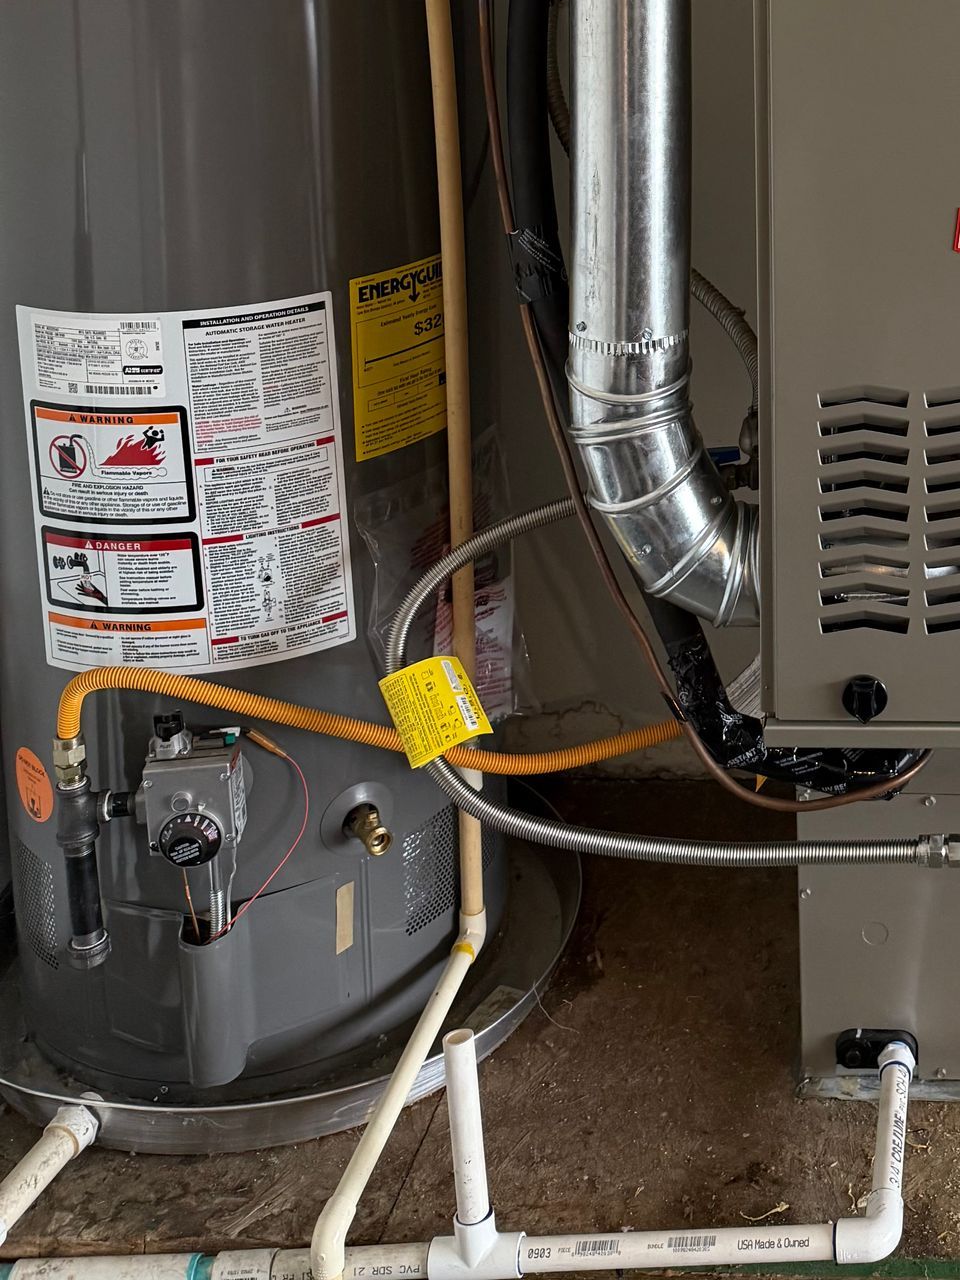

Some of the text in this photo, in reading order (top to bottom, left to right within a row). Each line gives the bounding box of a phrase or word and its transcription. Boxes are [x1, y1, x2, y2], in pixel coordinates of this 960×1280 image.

[358, 260, 442, 304] ENERGYGUI
[200, 317, 239, 326] INSTALLATION
[254, 310, 285, 320] OPERATION
[286, 306, 309, 315] DETAILS
[205, 327, 237, 336] AUTOMATIC
[239, 324, 264, 332] STORAGE
[284, 317, 305, 326] HEATER
[80, 414, 134, 424] WARNING
[271, 447, 289, 455] BEFORE
[290, 442, 315, 452] OPERATING
[245, 525, 300, 540] LIGHTING INSTRUCTIONS
[96, 542, 141, 550] DANGER
[102, 622, 151, 631] WARNING
[737, 1237, 810, 1250] USA Made & Owned
[527, 1248, 551, 1259] 0903
[353, 1265, 420, 1276] PVC SDR 21
